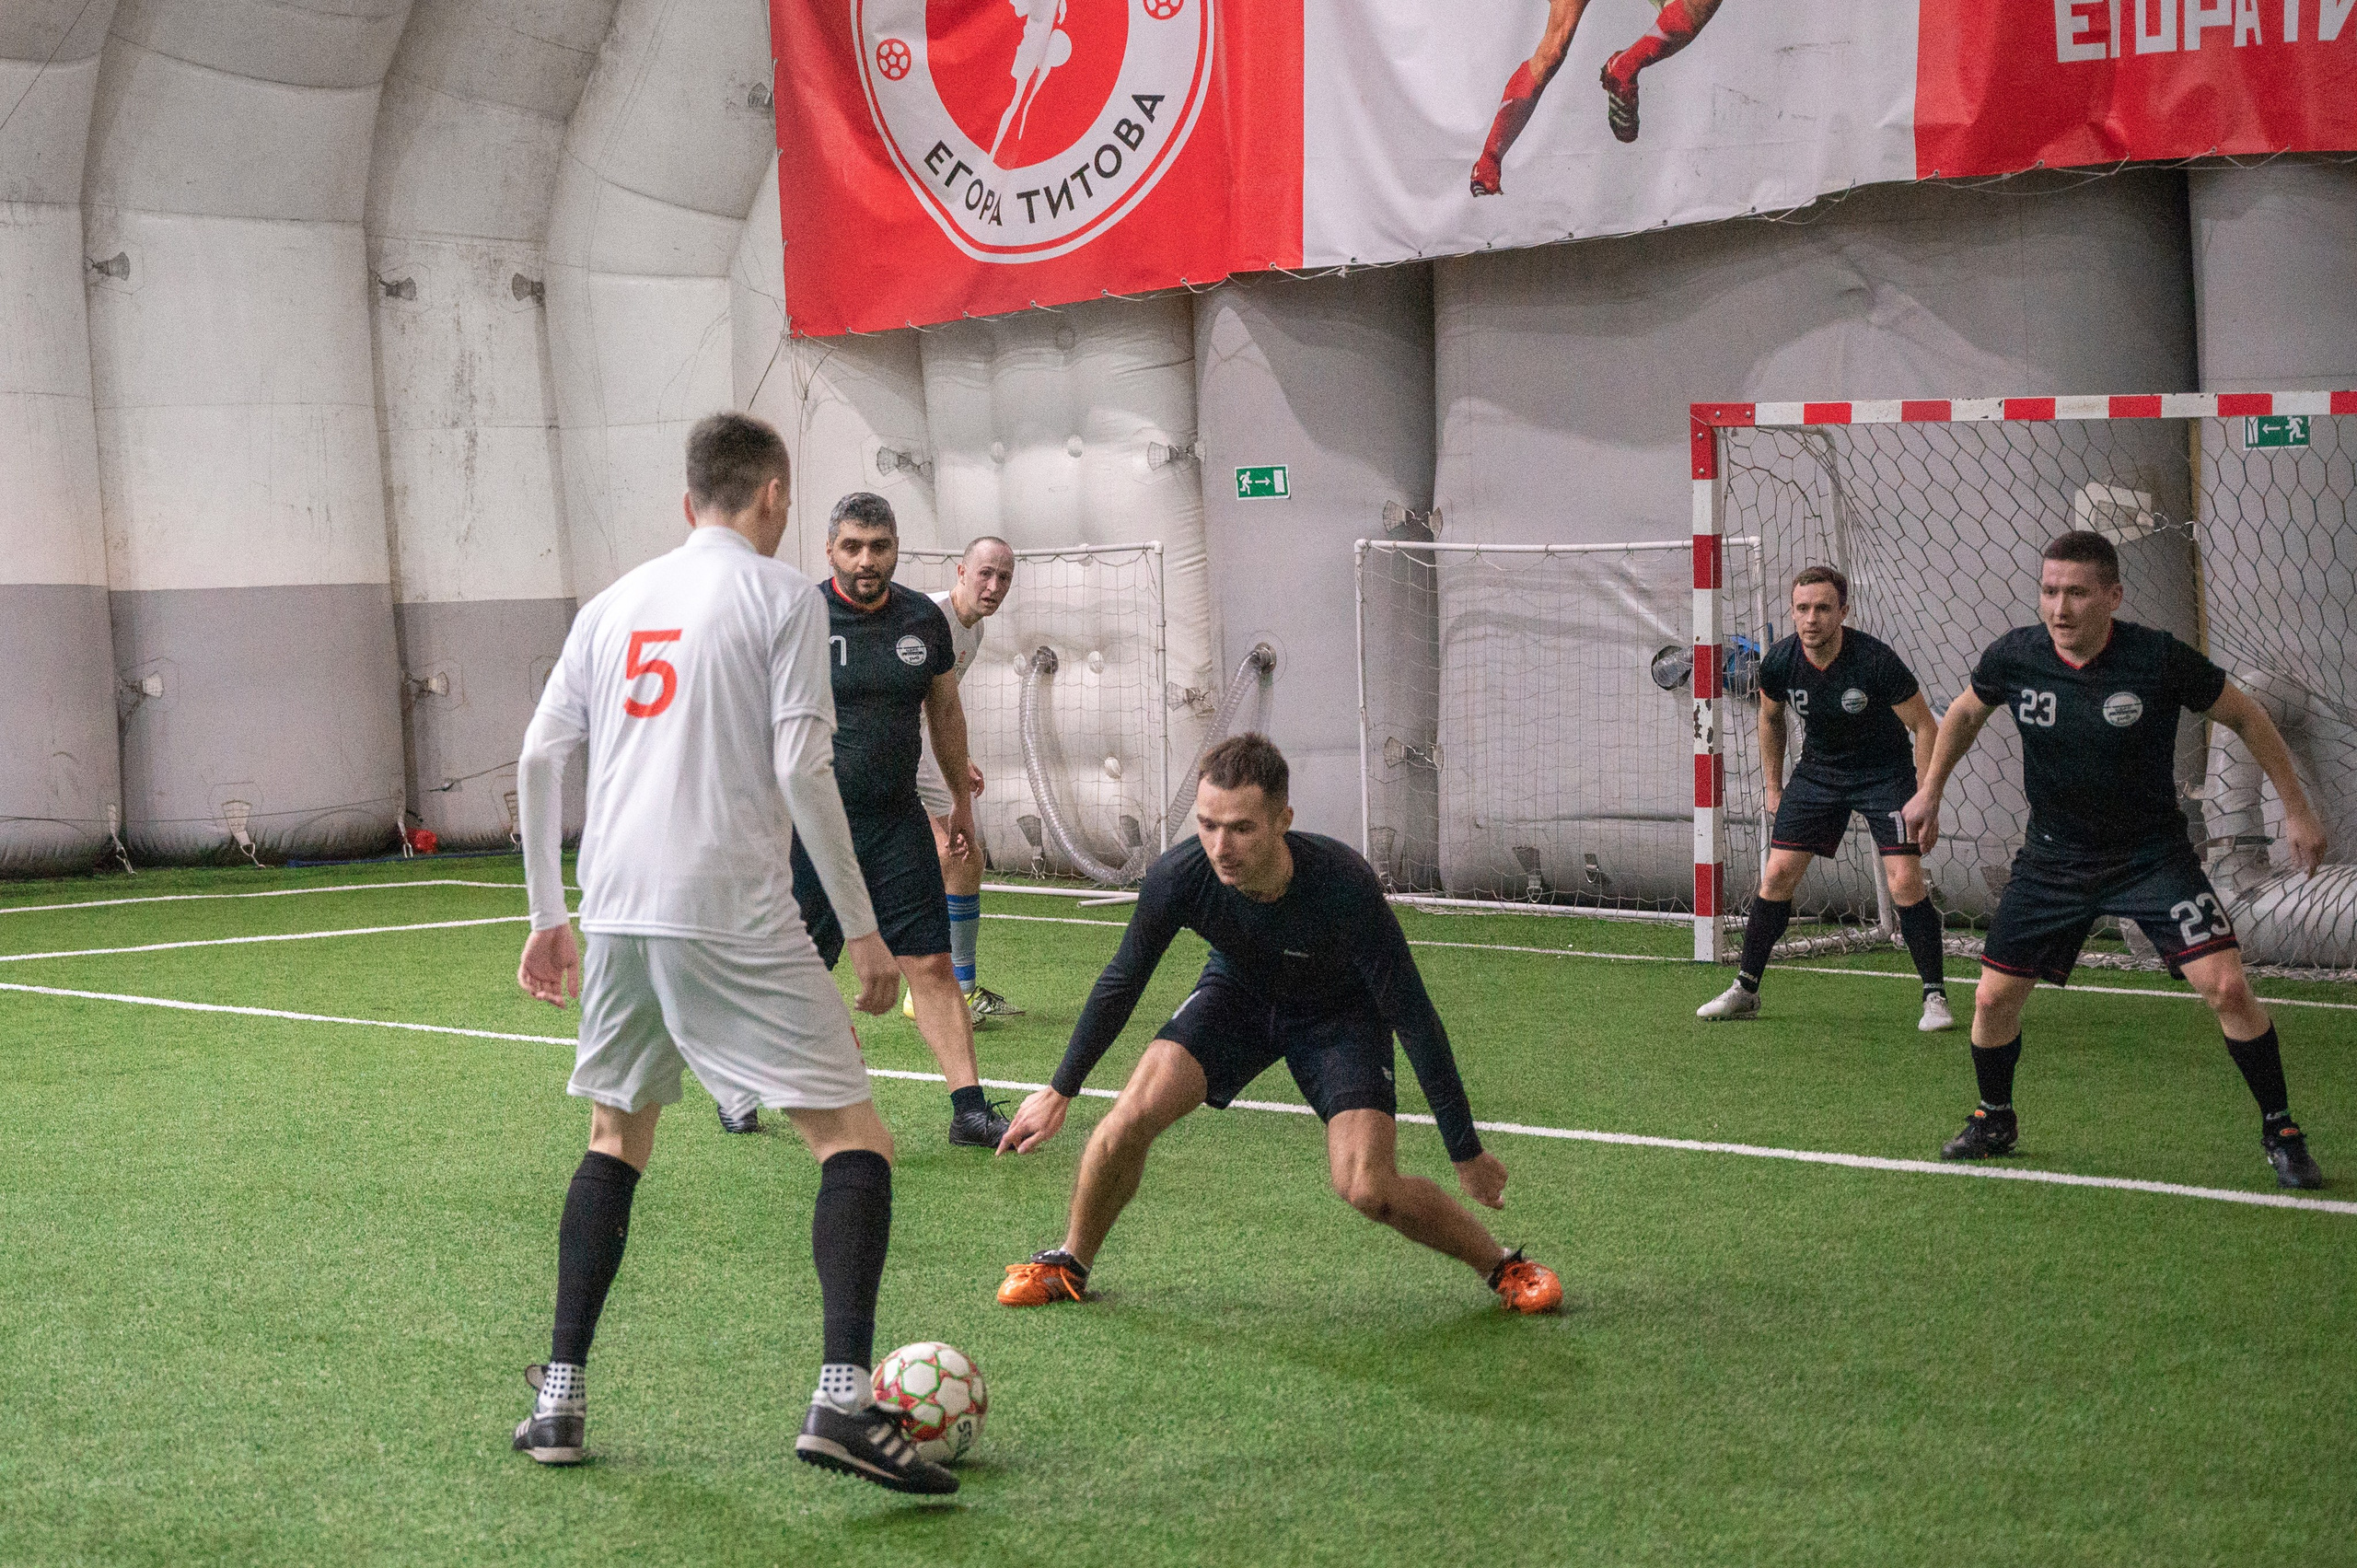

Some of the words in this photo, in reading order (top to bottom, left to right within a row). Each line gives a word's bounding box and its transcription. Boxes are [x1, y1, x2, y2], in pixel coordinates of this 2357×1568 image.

[923, 140, 1003, 227] ЕГОРА
[1016, 94, 1166, 224] ТИТОВА
[622, 628, 683, 718] 5
[1787, 689, 1809, 715] 12
[2019, 689, 2058, 727] 23
[2169, 892, 2232, 947] 23
